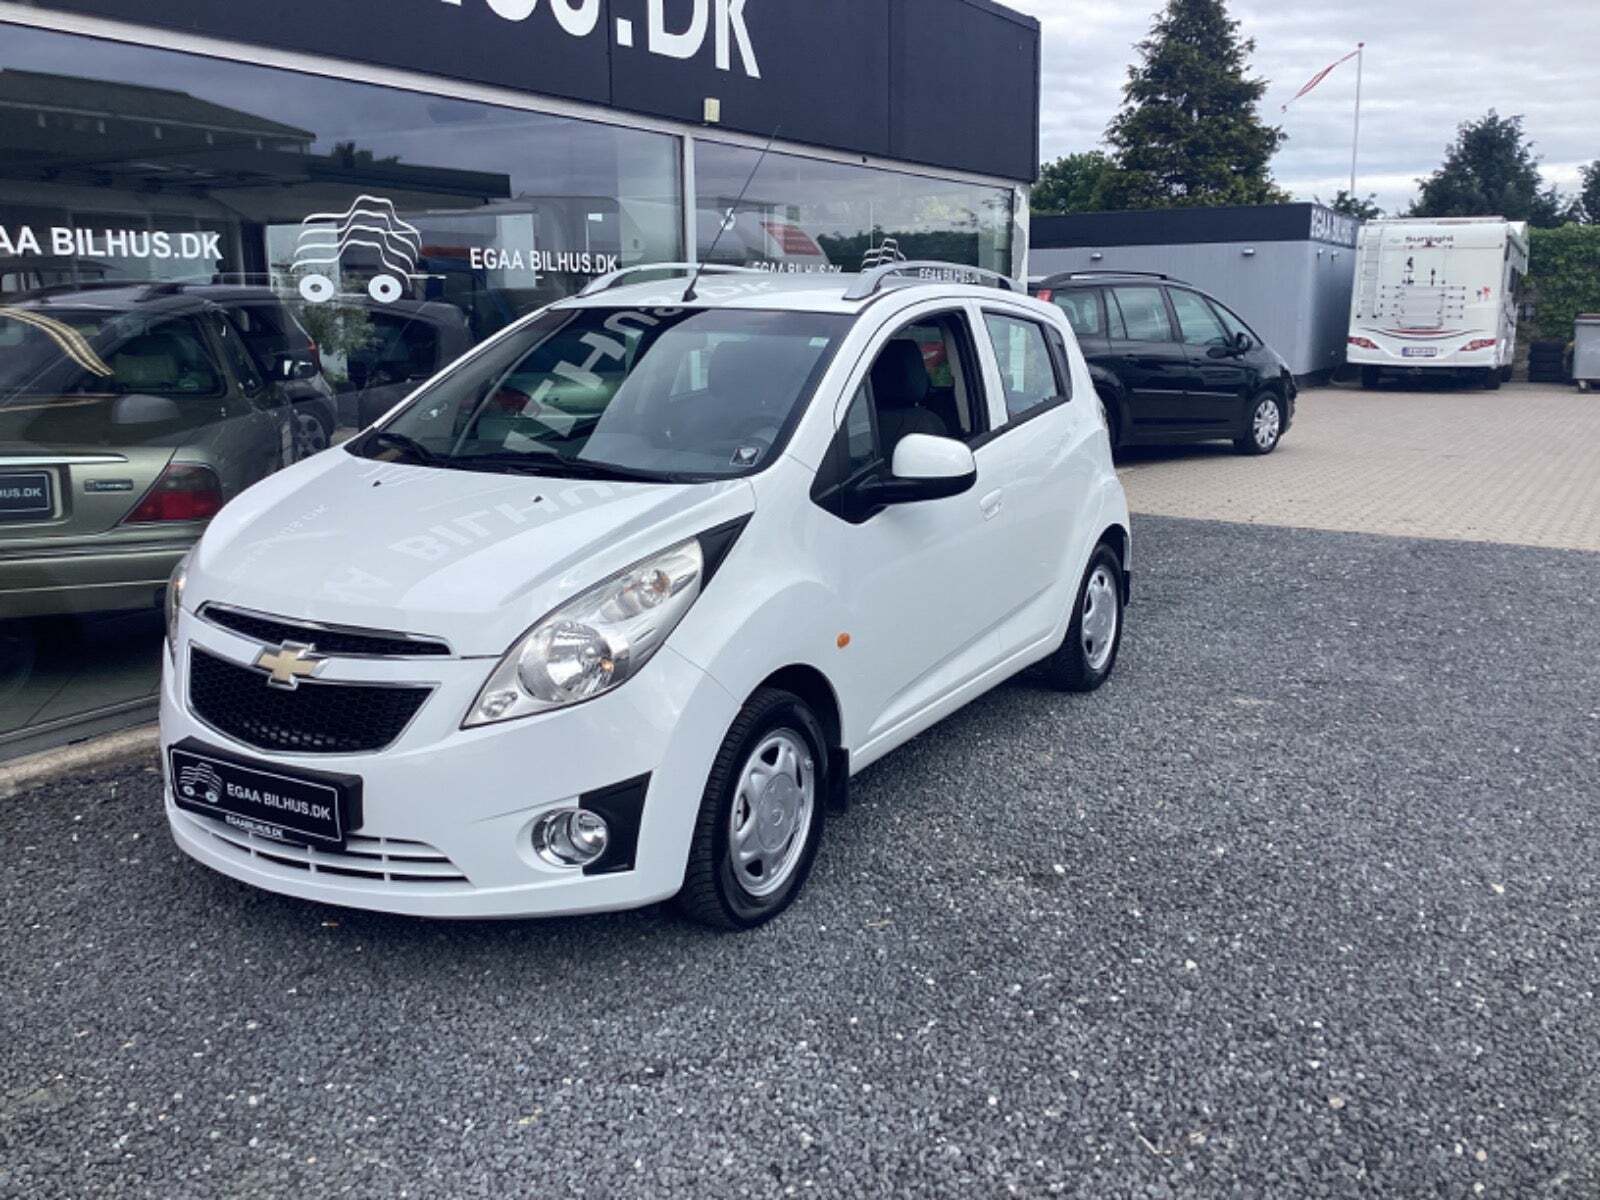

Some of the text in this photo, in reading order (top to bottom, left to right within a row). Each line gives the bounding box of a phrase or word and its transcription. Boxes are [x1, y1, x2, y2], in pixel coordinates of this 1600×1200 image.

[50, 226, 224, 261] BILHUS.DK
[470, 247, 618, 274] EGAA BILHUS.DK
[227, 782, 331, 821] EGAA BILHUS.DK
